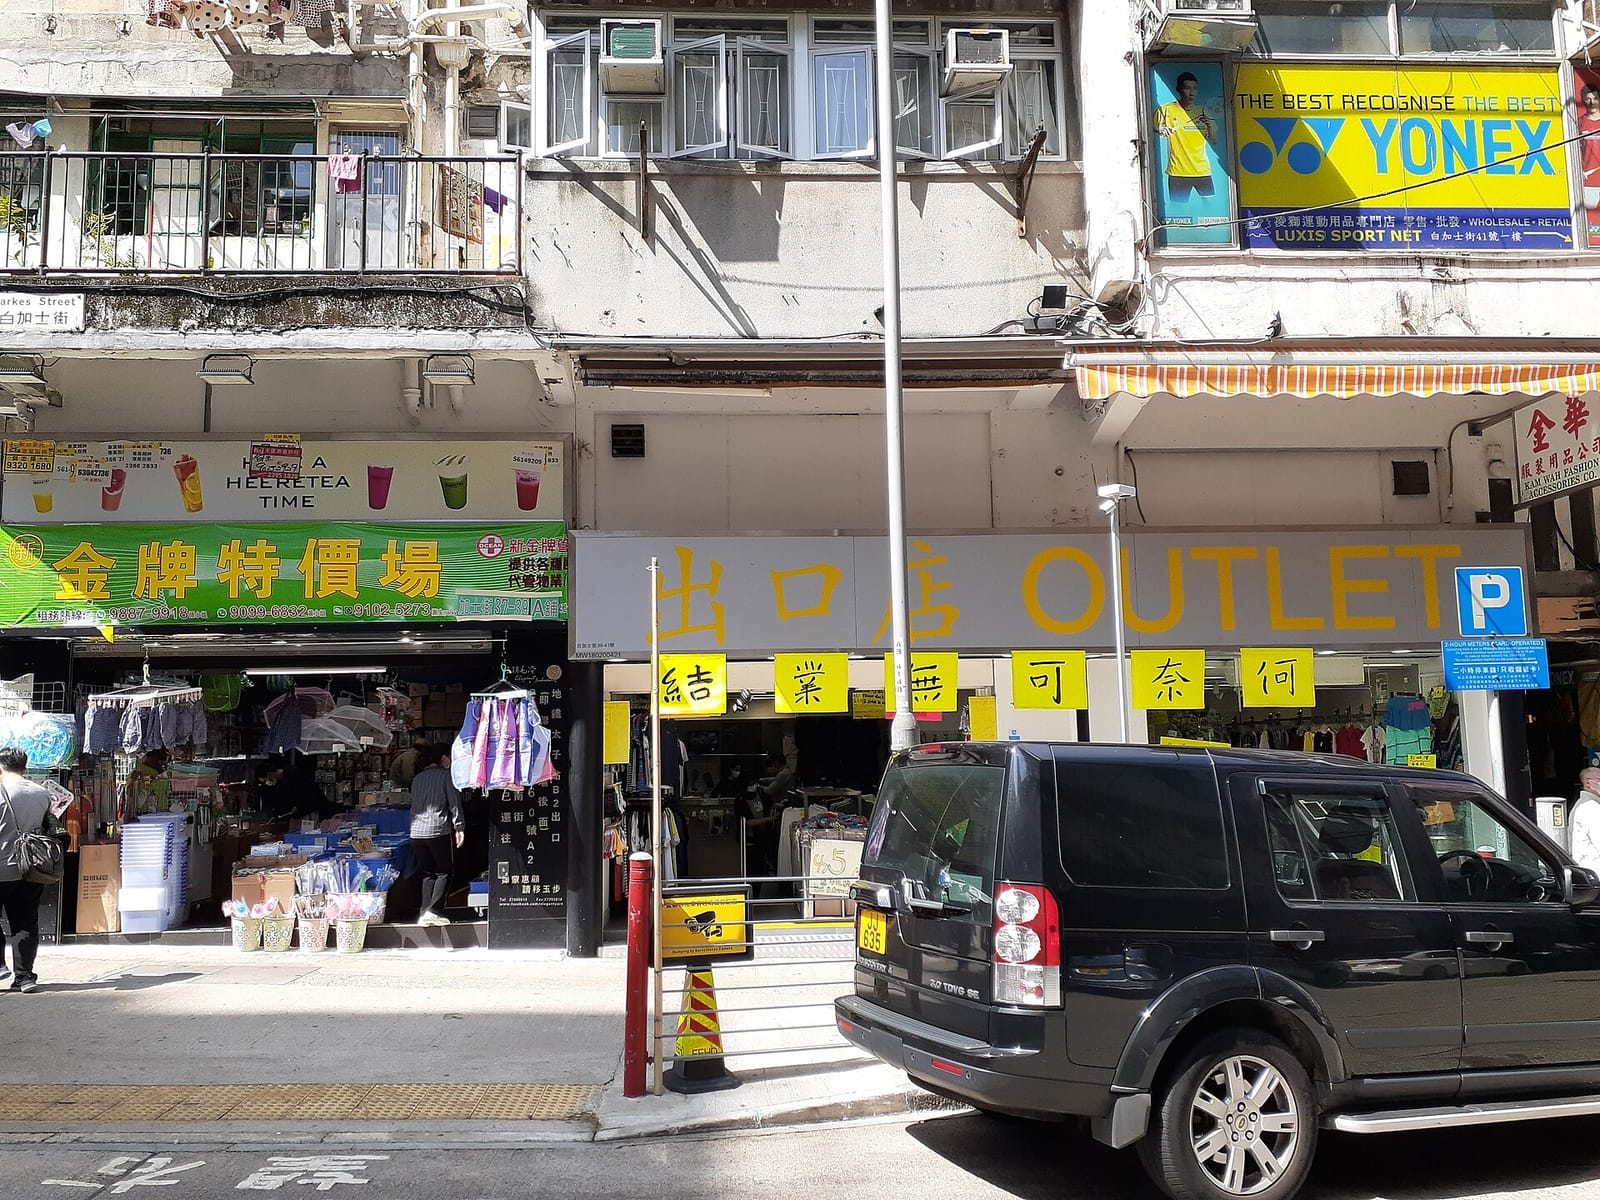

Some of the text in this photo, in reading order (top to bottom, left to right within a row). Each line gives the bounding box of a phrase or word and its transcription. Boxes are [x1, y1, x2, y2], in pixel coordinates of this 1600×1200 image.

[1236, 93, 1556, 112] THE BEST RECOGNISE THE BEST
[1359, 117, 1556, 176] YONEX
[1469, 217, 1531, 227] WHOLESALE
[1538, 218, 1572, 227] RETAIL
[1275, 229, 1326, 242] LUXIS
[1331, 229, 1386, 242] SPORT
[1391, 229, 1422, 242] NET
[39, 296, 76, 306] Street
[0, 311, 69, 325] 白加士街
[1526, 396, 1590, 454] 金華
[7, 462, 52, 471] 9320 1680
[312, 456, 328, 469] A
[1521, 436, 1600, 480] 服裝用品公司
[226, 475, 351, 489] HEERETEA
[1524, 457, 1600, 491] KAM WAH FASHION
[1529, 470, 1598, 499] ACCESSORIES CO.
[259, 495, 315, 509] TIME
[52, 538, 443, 602] 金牌特價場
[646, 541, 959, 646] 出口店
[1022, 545, 1462, 634] OUTLET
[230, 605, 308, 619] 9099-6832
[352, 603, 432, 617] 9102-5273
[1470, 573, 1510, 630] P
[109, 606, 188, 620] 9887-9918
[661, 665, 714, 702] 結
[793, 661, 826, 704] 業
[1029, 660, 1066, 704] 可
[1156, 658, 1191, 702] 奈
[1256, 658, 1298, 696] 何
[867, 911, 880, 932] JJ
[863, 930, 881, 951] 635
[966, 987, 980, 1000] SE
